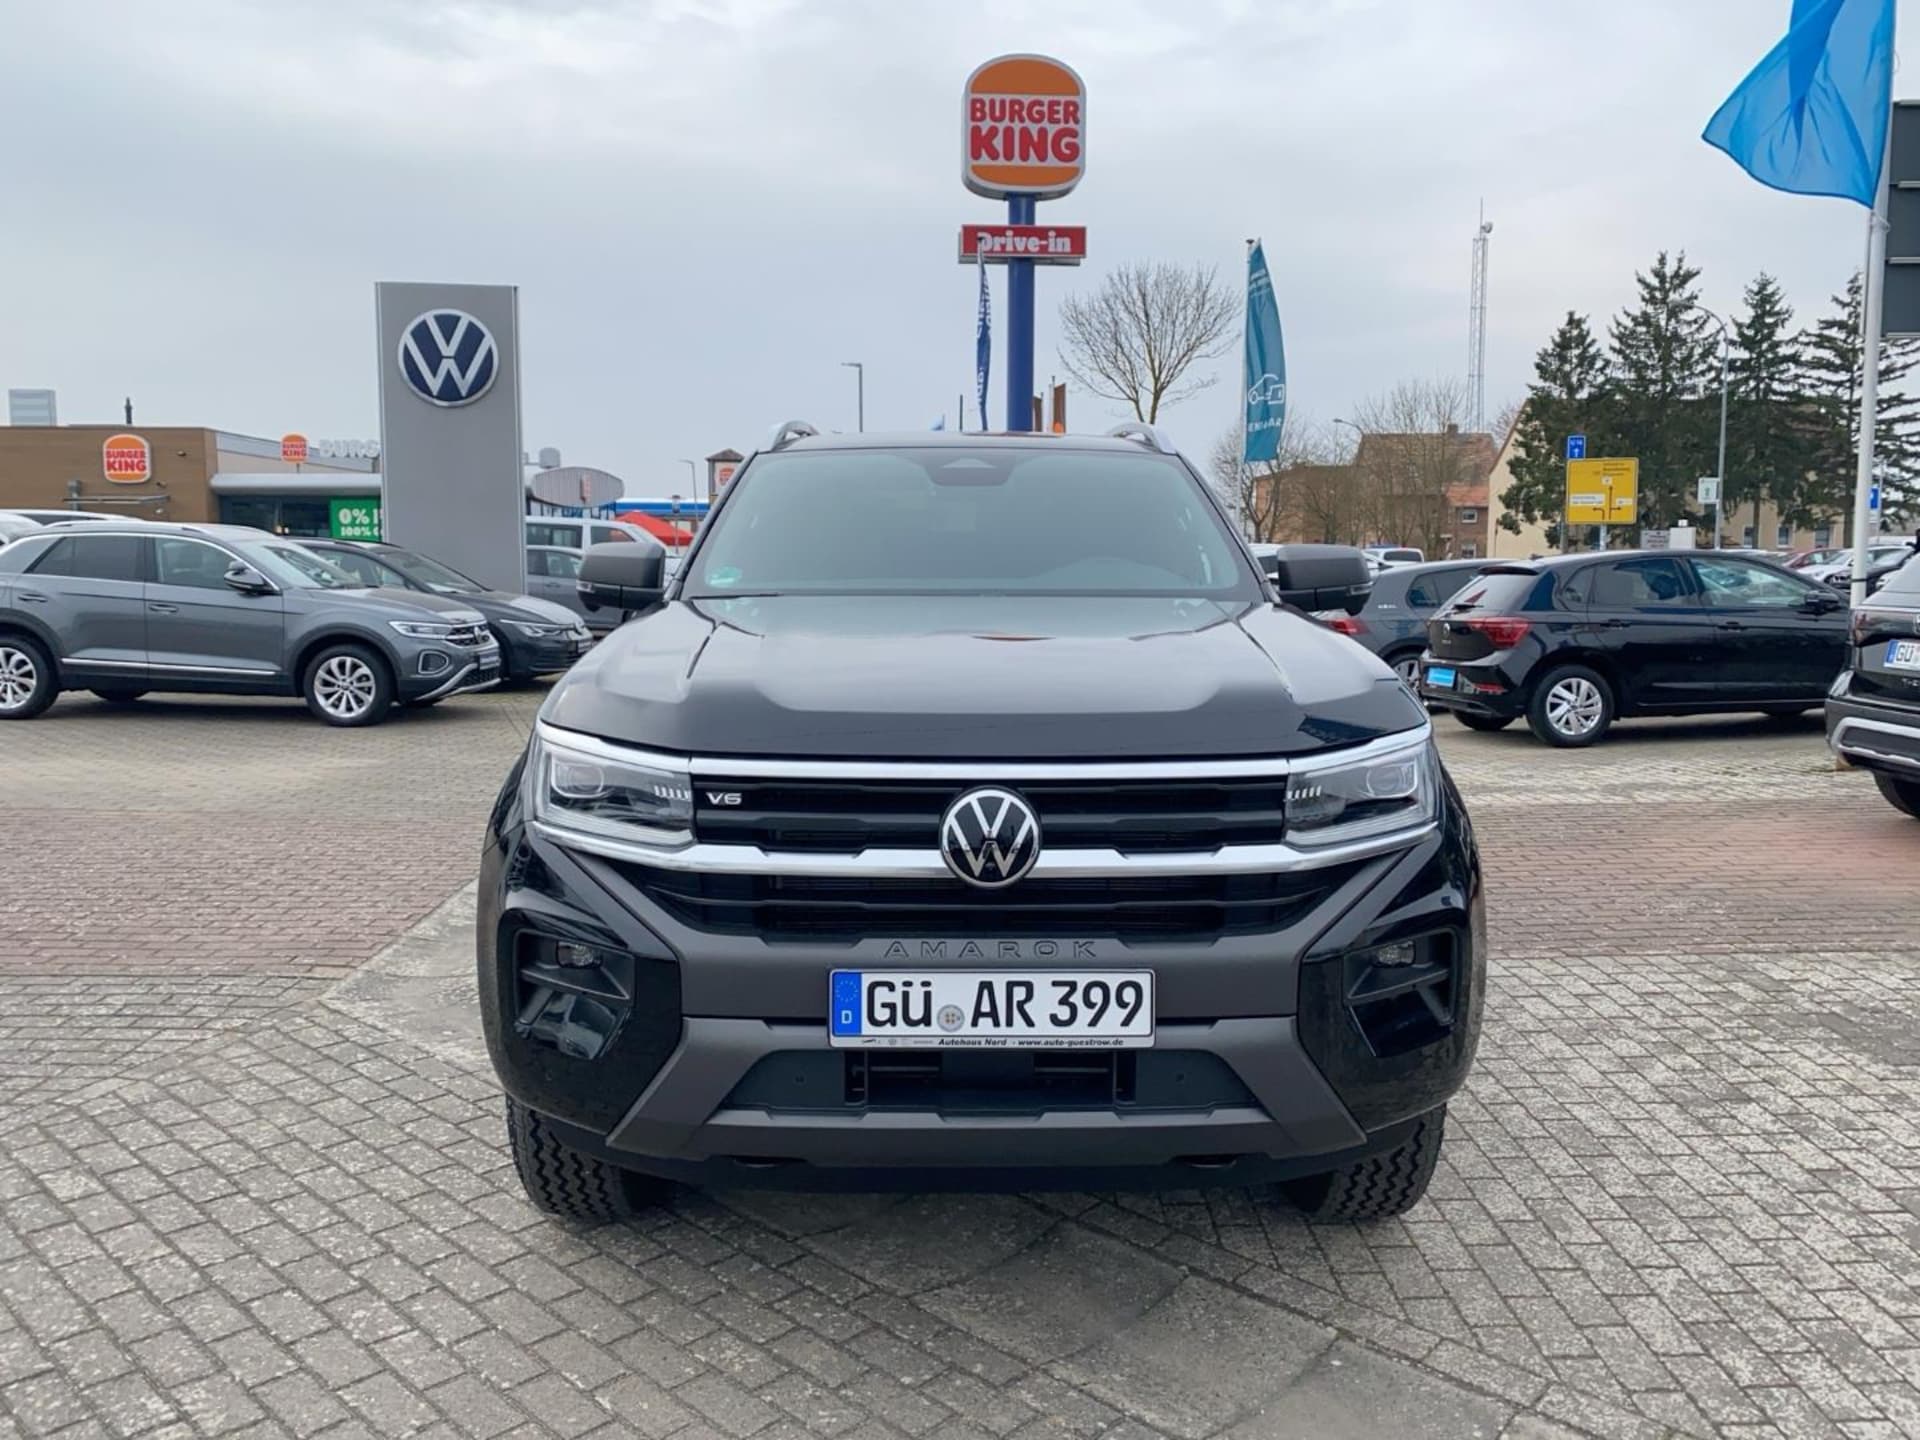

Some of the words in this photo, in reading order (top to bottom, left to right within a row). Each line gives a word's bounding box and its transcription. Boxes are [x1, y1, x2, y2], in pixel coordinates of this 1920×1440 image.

[970, 97, 1080, 125] BURGER
[970, 125, 1080, 162] KING
[977, 230, 1071, 253] Drive-in
[106, 450, 146, 459] BURGER
[106, 460, 146, 471] KING
[338, 508, 370, 525] 0%
[341, 527, 371, 537] 100%
[707, 793, 742, 805] V6
[884, 940, 1096, 959] AMAROK
[867, 980, 932, 1028] GÜ
[970, 980, 1036, 1028] AR
[1049, 980, 1144, 1028] 399
[841, 1010, 853, 1024] D
[938, 1038, 982, 1046] Autohaus
[984, 1038, 1007, 1046] Nord
